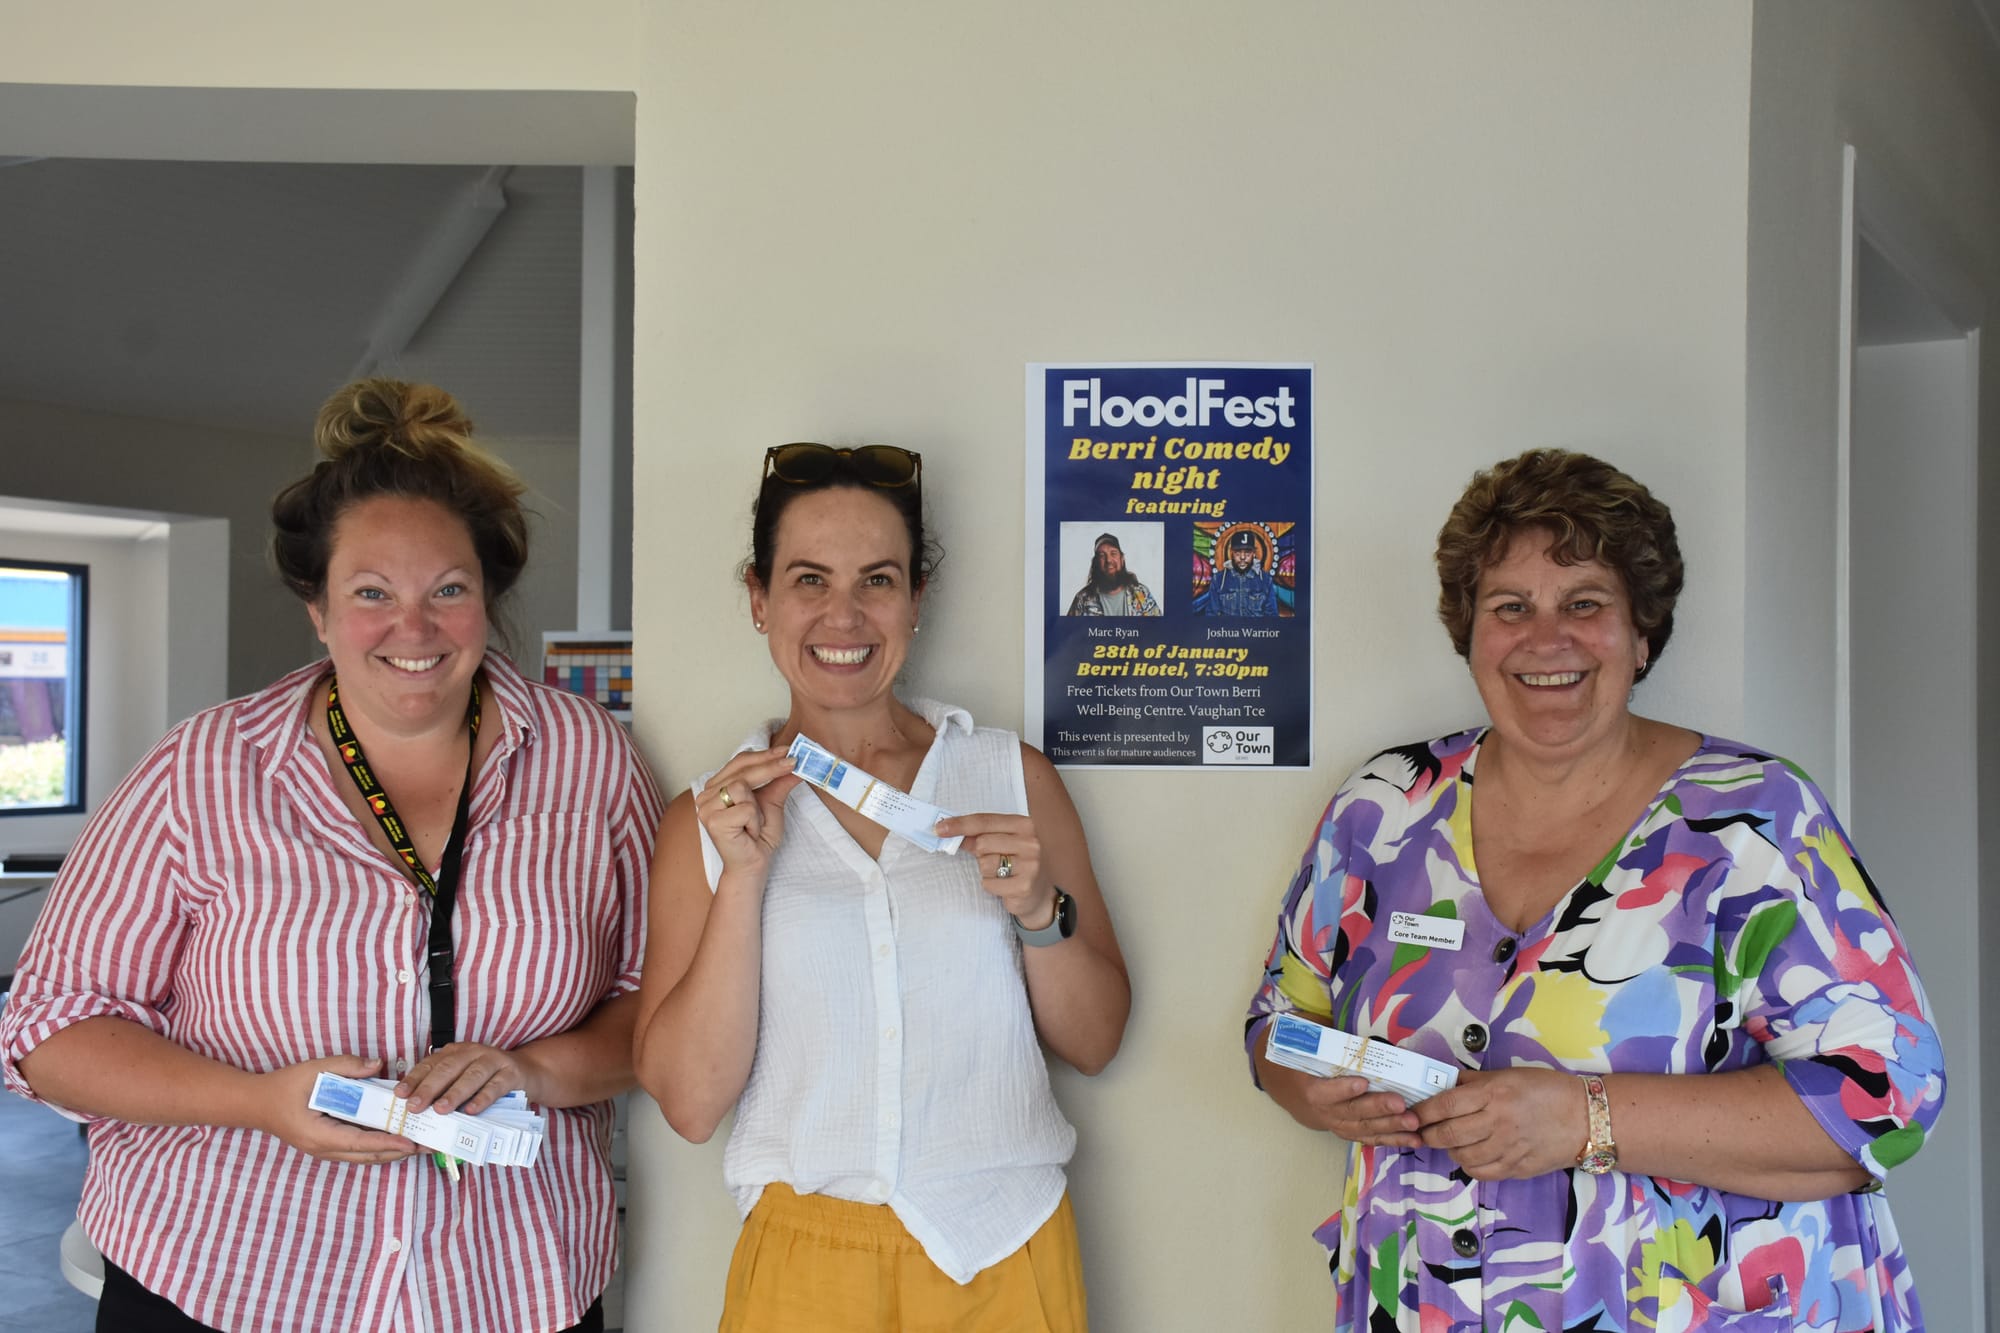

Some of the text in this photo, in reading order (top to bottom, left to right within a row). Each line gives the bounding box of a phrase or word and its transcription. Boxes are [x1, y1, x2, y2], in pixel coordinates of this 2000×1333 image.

[1063, 377, 1296, 428] FloodFest
[1068, 436, 1290, 466] Berri Comedy
[1131, 466, 1221, 495] night
[1125, 498, 1227, 518] featuring
[1088, 627, 1139, 639] Marc Ryan
[1207, 627, 1280, 640] Joshua Warrior
[1093, 644, 1249, 662] 28th of January
[1076, 661, 1269, 680] Berri Hotel, 7:30pm
[1067, 684, 1261, 697] Free Tickets from Our Town Berri
[1077, 703, 1266, 720] Well-Being Centre. Vaughan Tce
[1058, 731, 1190, 745] This event is presented by
[1235, 731, 1260, 742] Our
[1051, 747, 1196, 757] This event is for mature audiences
[1235, 743, 1271, 754] Town
[1394, 930, 1455, 944] Core Team Member
[1434, 1074, 1440, 1085] 1
[460, 1135, 475, 1148] 101
